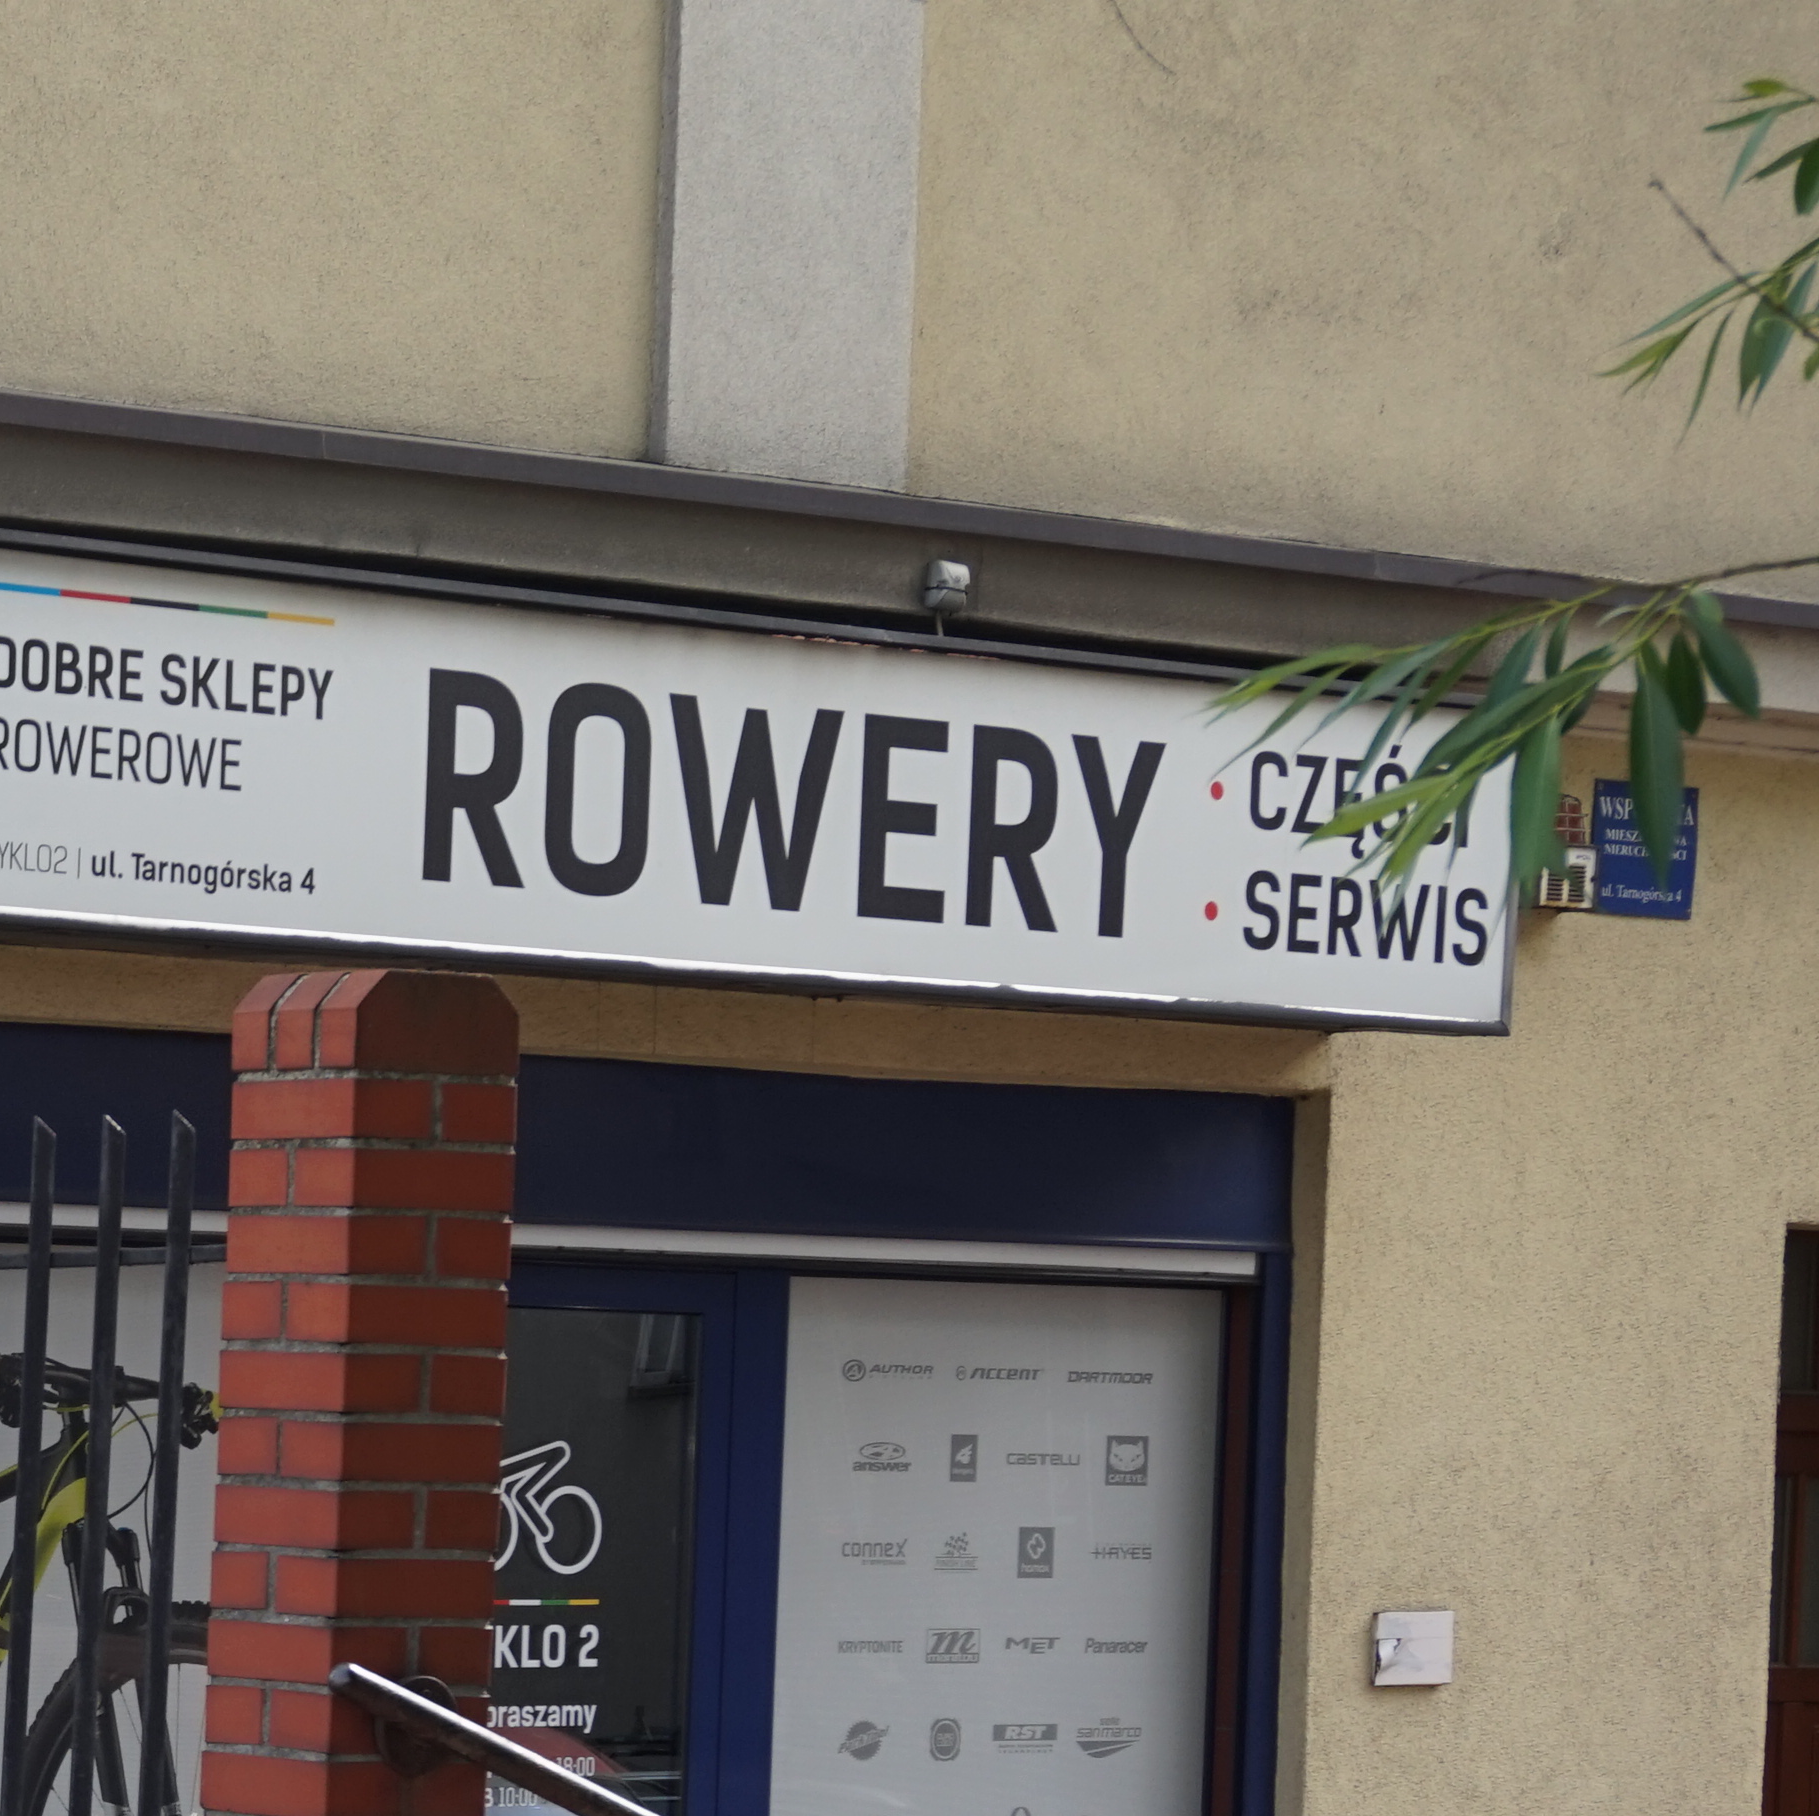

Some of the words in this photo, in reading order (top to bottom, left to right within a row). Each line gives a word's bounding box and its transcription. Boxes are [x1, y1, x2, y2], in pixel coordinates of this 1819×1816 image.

[160, 653, 334, 720] SKLEPY
[421, 667, 1167, 938] ROWERY
[90, 850, 124, 879] ul.
[131, 852, 293, 894] Tarnogórska
[300, 867, 316, 895] 4
[1616, 884, 1674, 904] Tarnogórsa
[1242, 869, 1489, 967] SERWIS
[869, 1363, 934, 1375] AUTHOR
[1066, 1370, 1154, 1385] DARTMOOR
[852, 1460, 912, 1473] answer
[1107, 1473, 1145, 1484] CATEYE
[1090, 1546, 1153, 1561] HAYES
[493, 1623, 566, 1669] KLO
[578, 1623, 599, 1668] 2
[837, 1639, 905, 1655] KRYPTONITE
[1004, 1636, 1061, 1655] MET
[1084, 1637, 1149, 1655] Panaracer
[1003, 1725, 1048, 1741] RST
